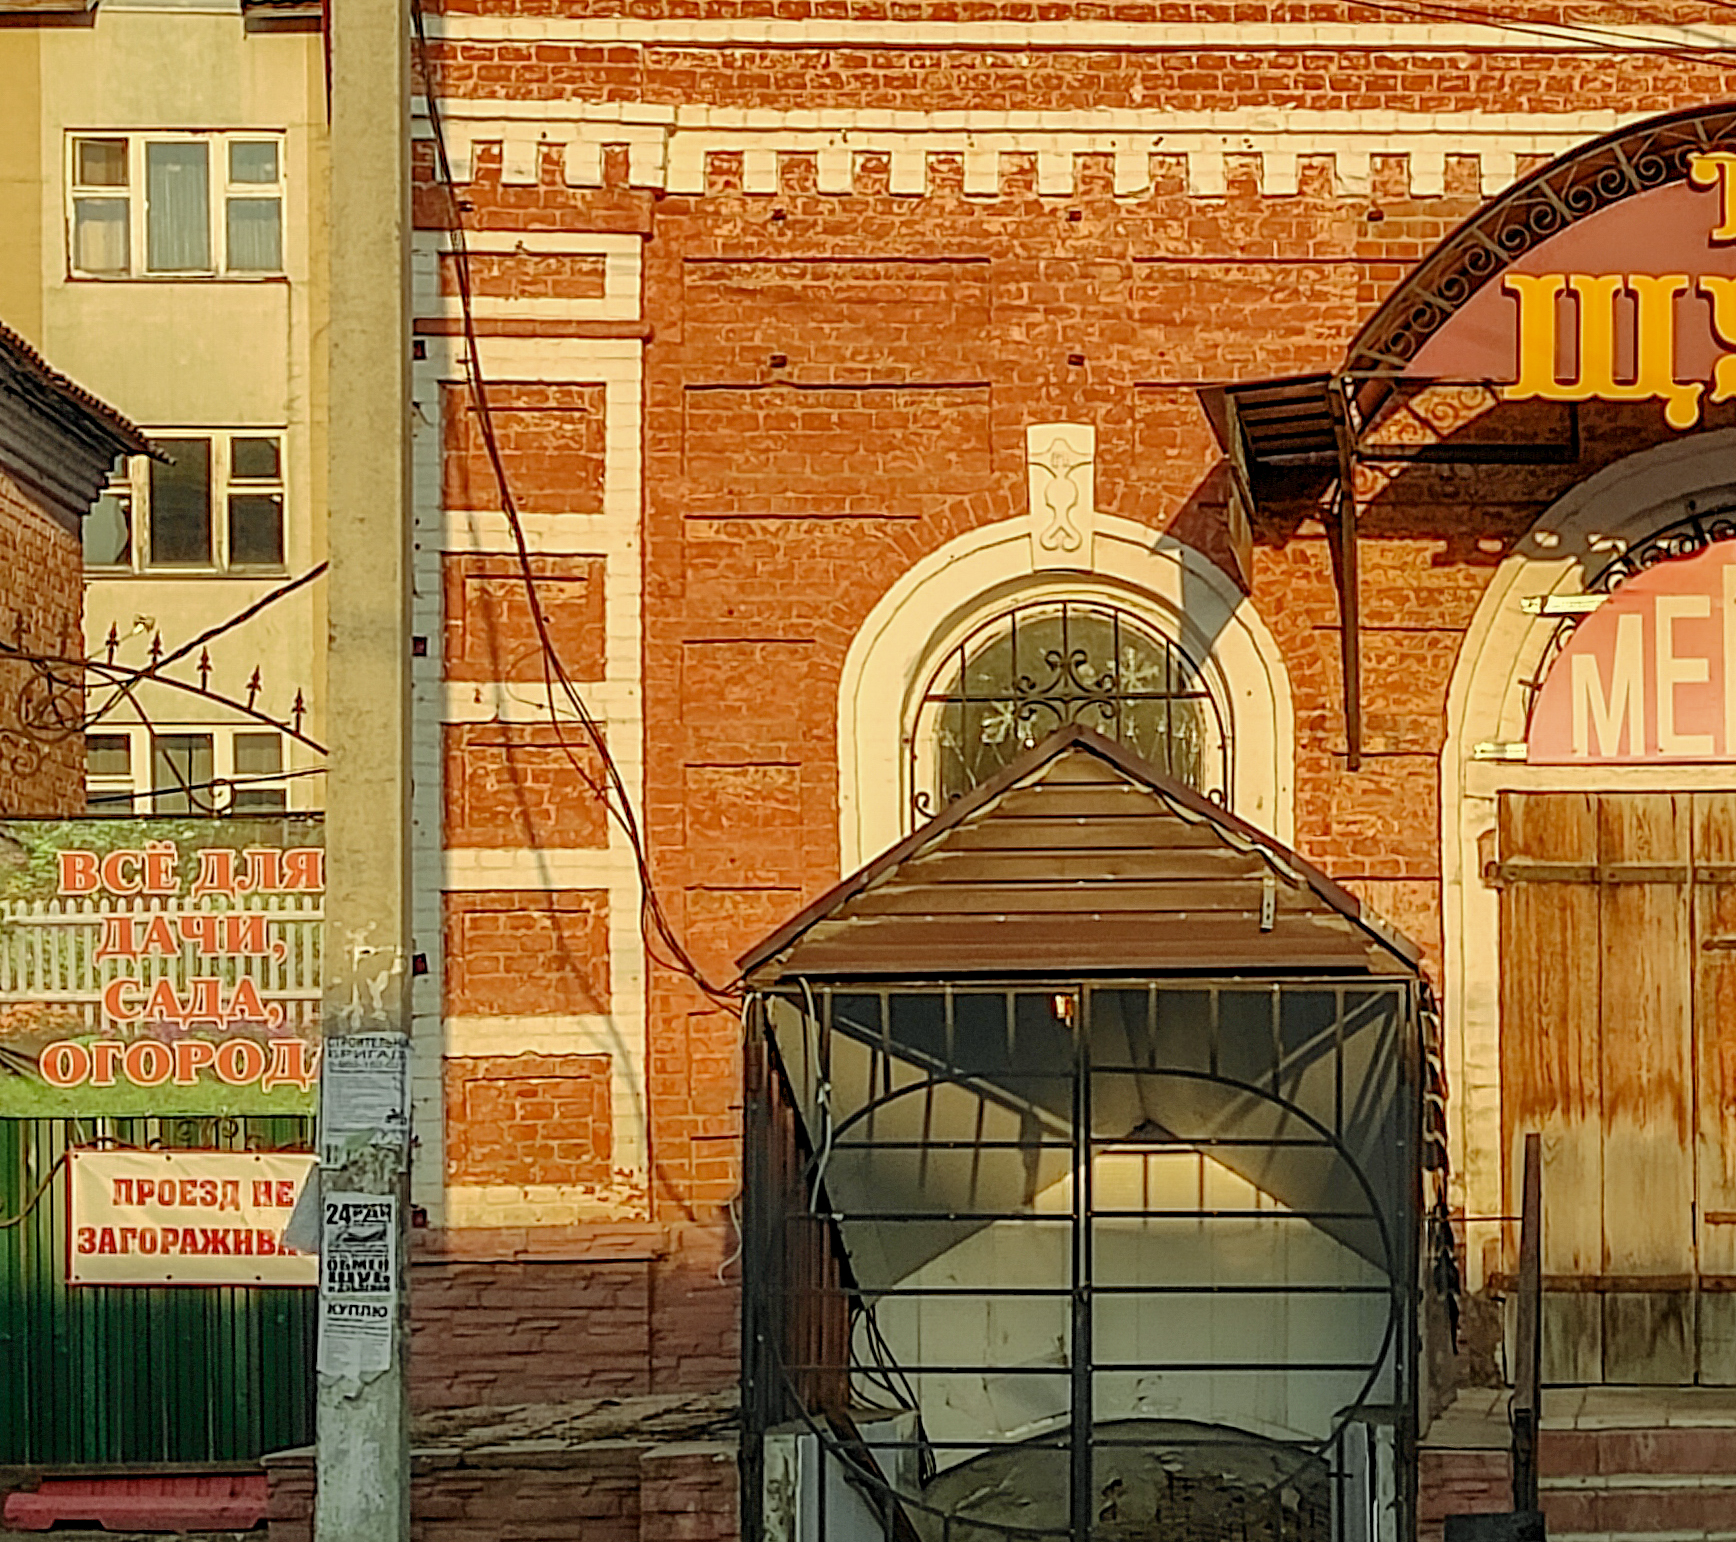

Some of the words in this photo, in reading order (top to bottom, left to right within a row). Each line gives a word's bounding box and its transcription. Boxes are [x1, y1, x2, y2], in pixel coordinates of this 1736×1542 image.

[57, 840, 181, 896] ВСЁ
[191, 847, 325, 902] ДЛЯ
[93, 913, 288, 967] ДАЧИ,
[102, 975, 284, 1030] САДА,
[112, 1178, 241, 1211] ПРОЕЗД
[253, 1180, 295, 1207] НЕ
[326, 1203, 351, 1225] 24
[326, 1302, 388, 1318] КУПЛЮ
